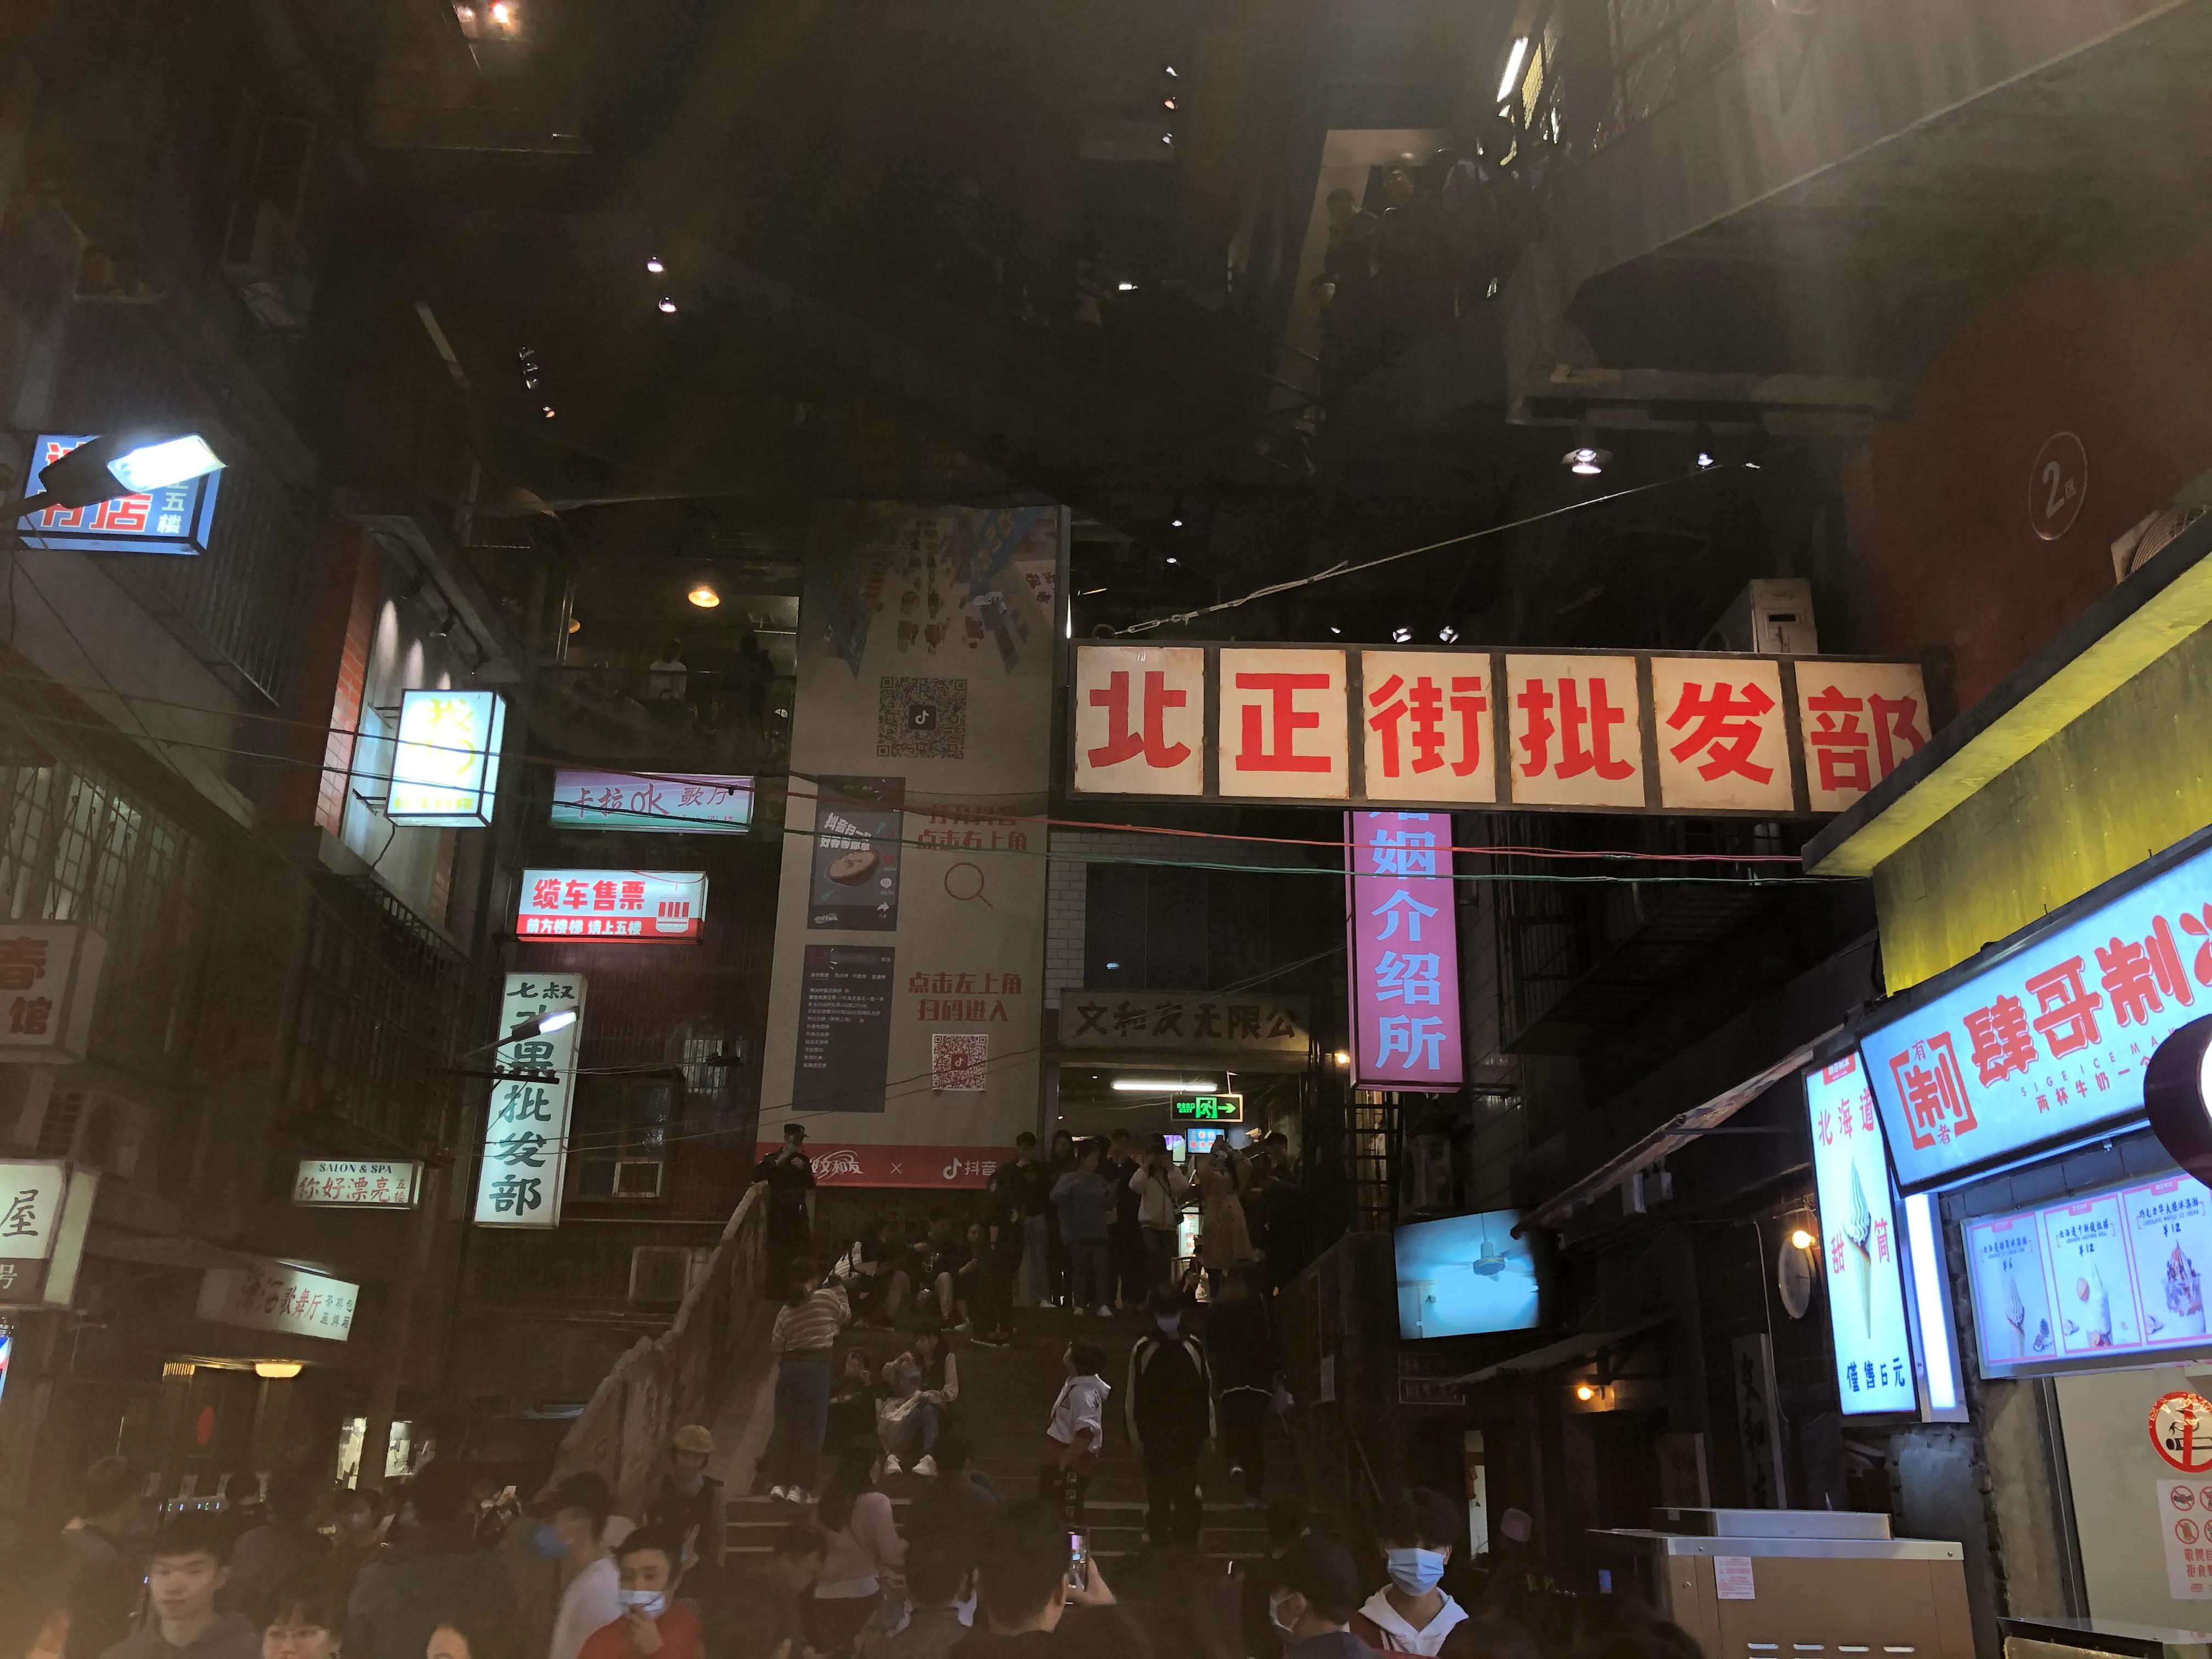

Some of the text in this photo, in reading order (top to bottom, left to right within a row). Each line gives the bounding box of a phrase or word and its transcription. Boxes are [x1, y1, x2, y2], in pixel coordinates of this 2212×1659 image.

[1088, 670, 1928, 792] 北正街批发部
[678, 786, 730, 807] 歌厅
[916, 829, 1027, 851] 点击右上角
[532, 879, 646, 911] 缆车售票
[526, 918, 642, 936] 前方楼梯 请上五楼
[1369, 812, 1447, 1070] 姻介绍所
[506, 981, 575, 1000] 七叔
[908, 972, 1022, 995] 点击左上角
[9, 996, 53, 1035] 馆
[917, 999, 1009, 1022] 扫码进入
[1075, 1000, 1299, 1040] 文和友无限公
[1818, 1087, 1874, 1147] 北海道
[319, 1163, 392, 1174] SALON & SPA
[964, 1160, 997, 1176] 抖音
[298, 1176, 390, 1203] 你好漂亮
[0, 1189, 40, 1237] 屋
